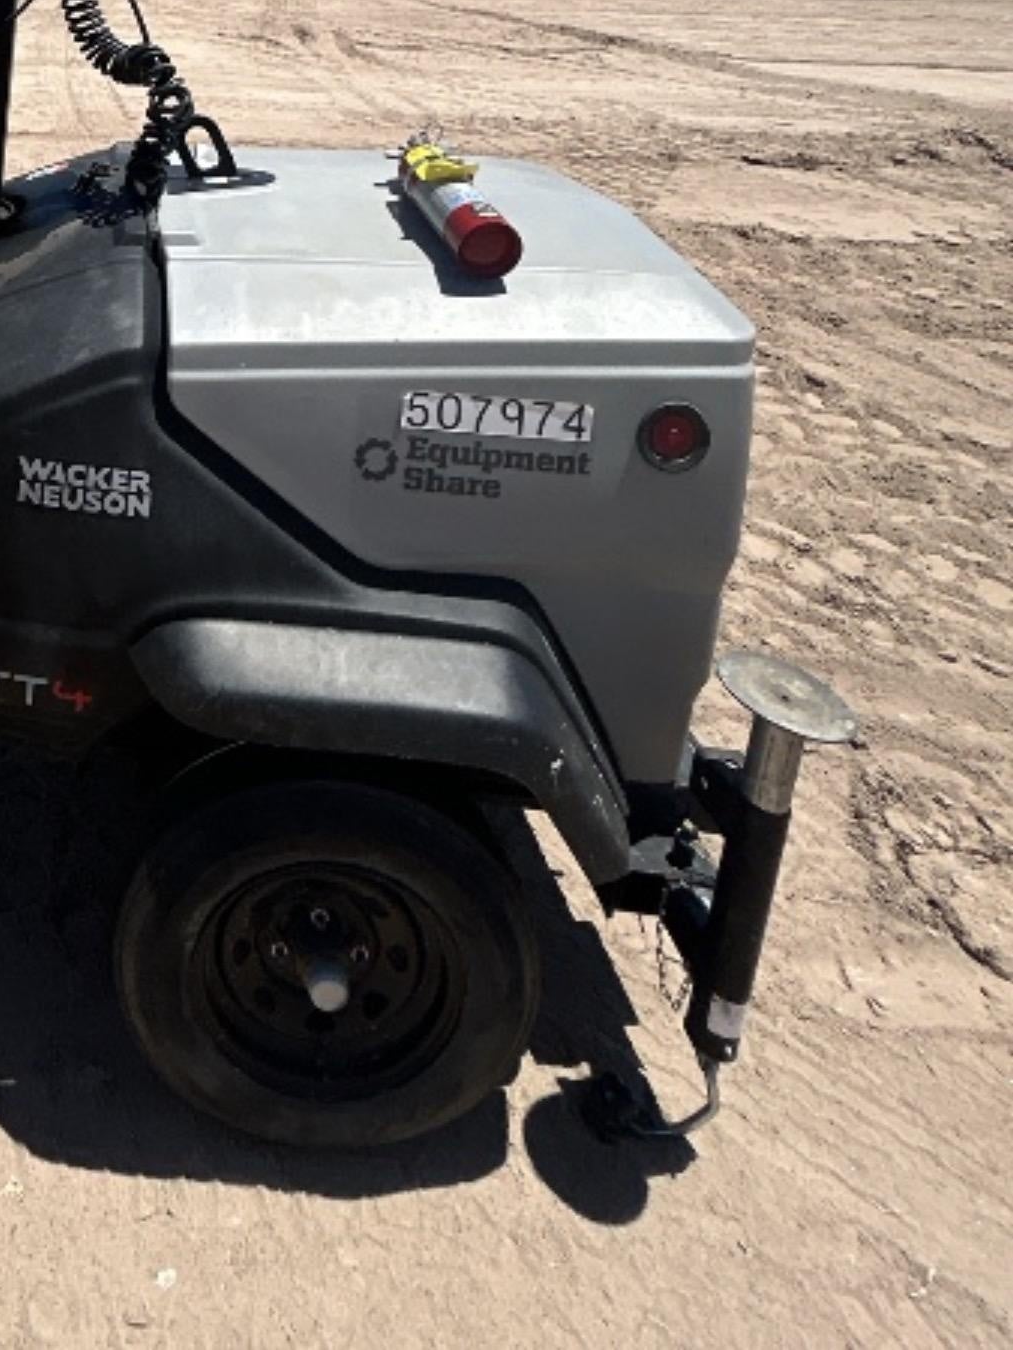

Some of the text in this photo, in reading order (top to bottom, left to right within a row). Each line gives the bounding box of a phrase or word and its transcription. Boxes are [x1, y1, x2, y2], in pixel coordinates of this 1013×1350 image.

[405, 391, 587, 440] 507974
[18, 454, 152, 494] WACKER
[405, 435, 593, 475] Equipment
[17, 479, 152, 520] NEUSON
[403, 466, 502, 499] Share
